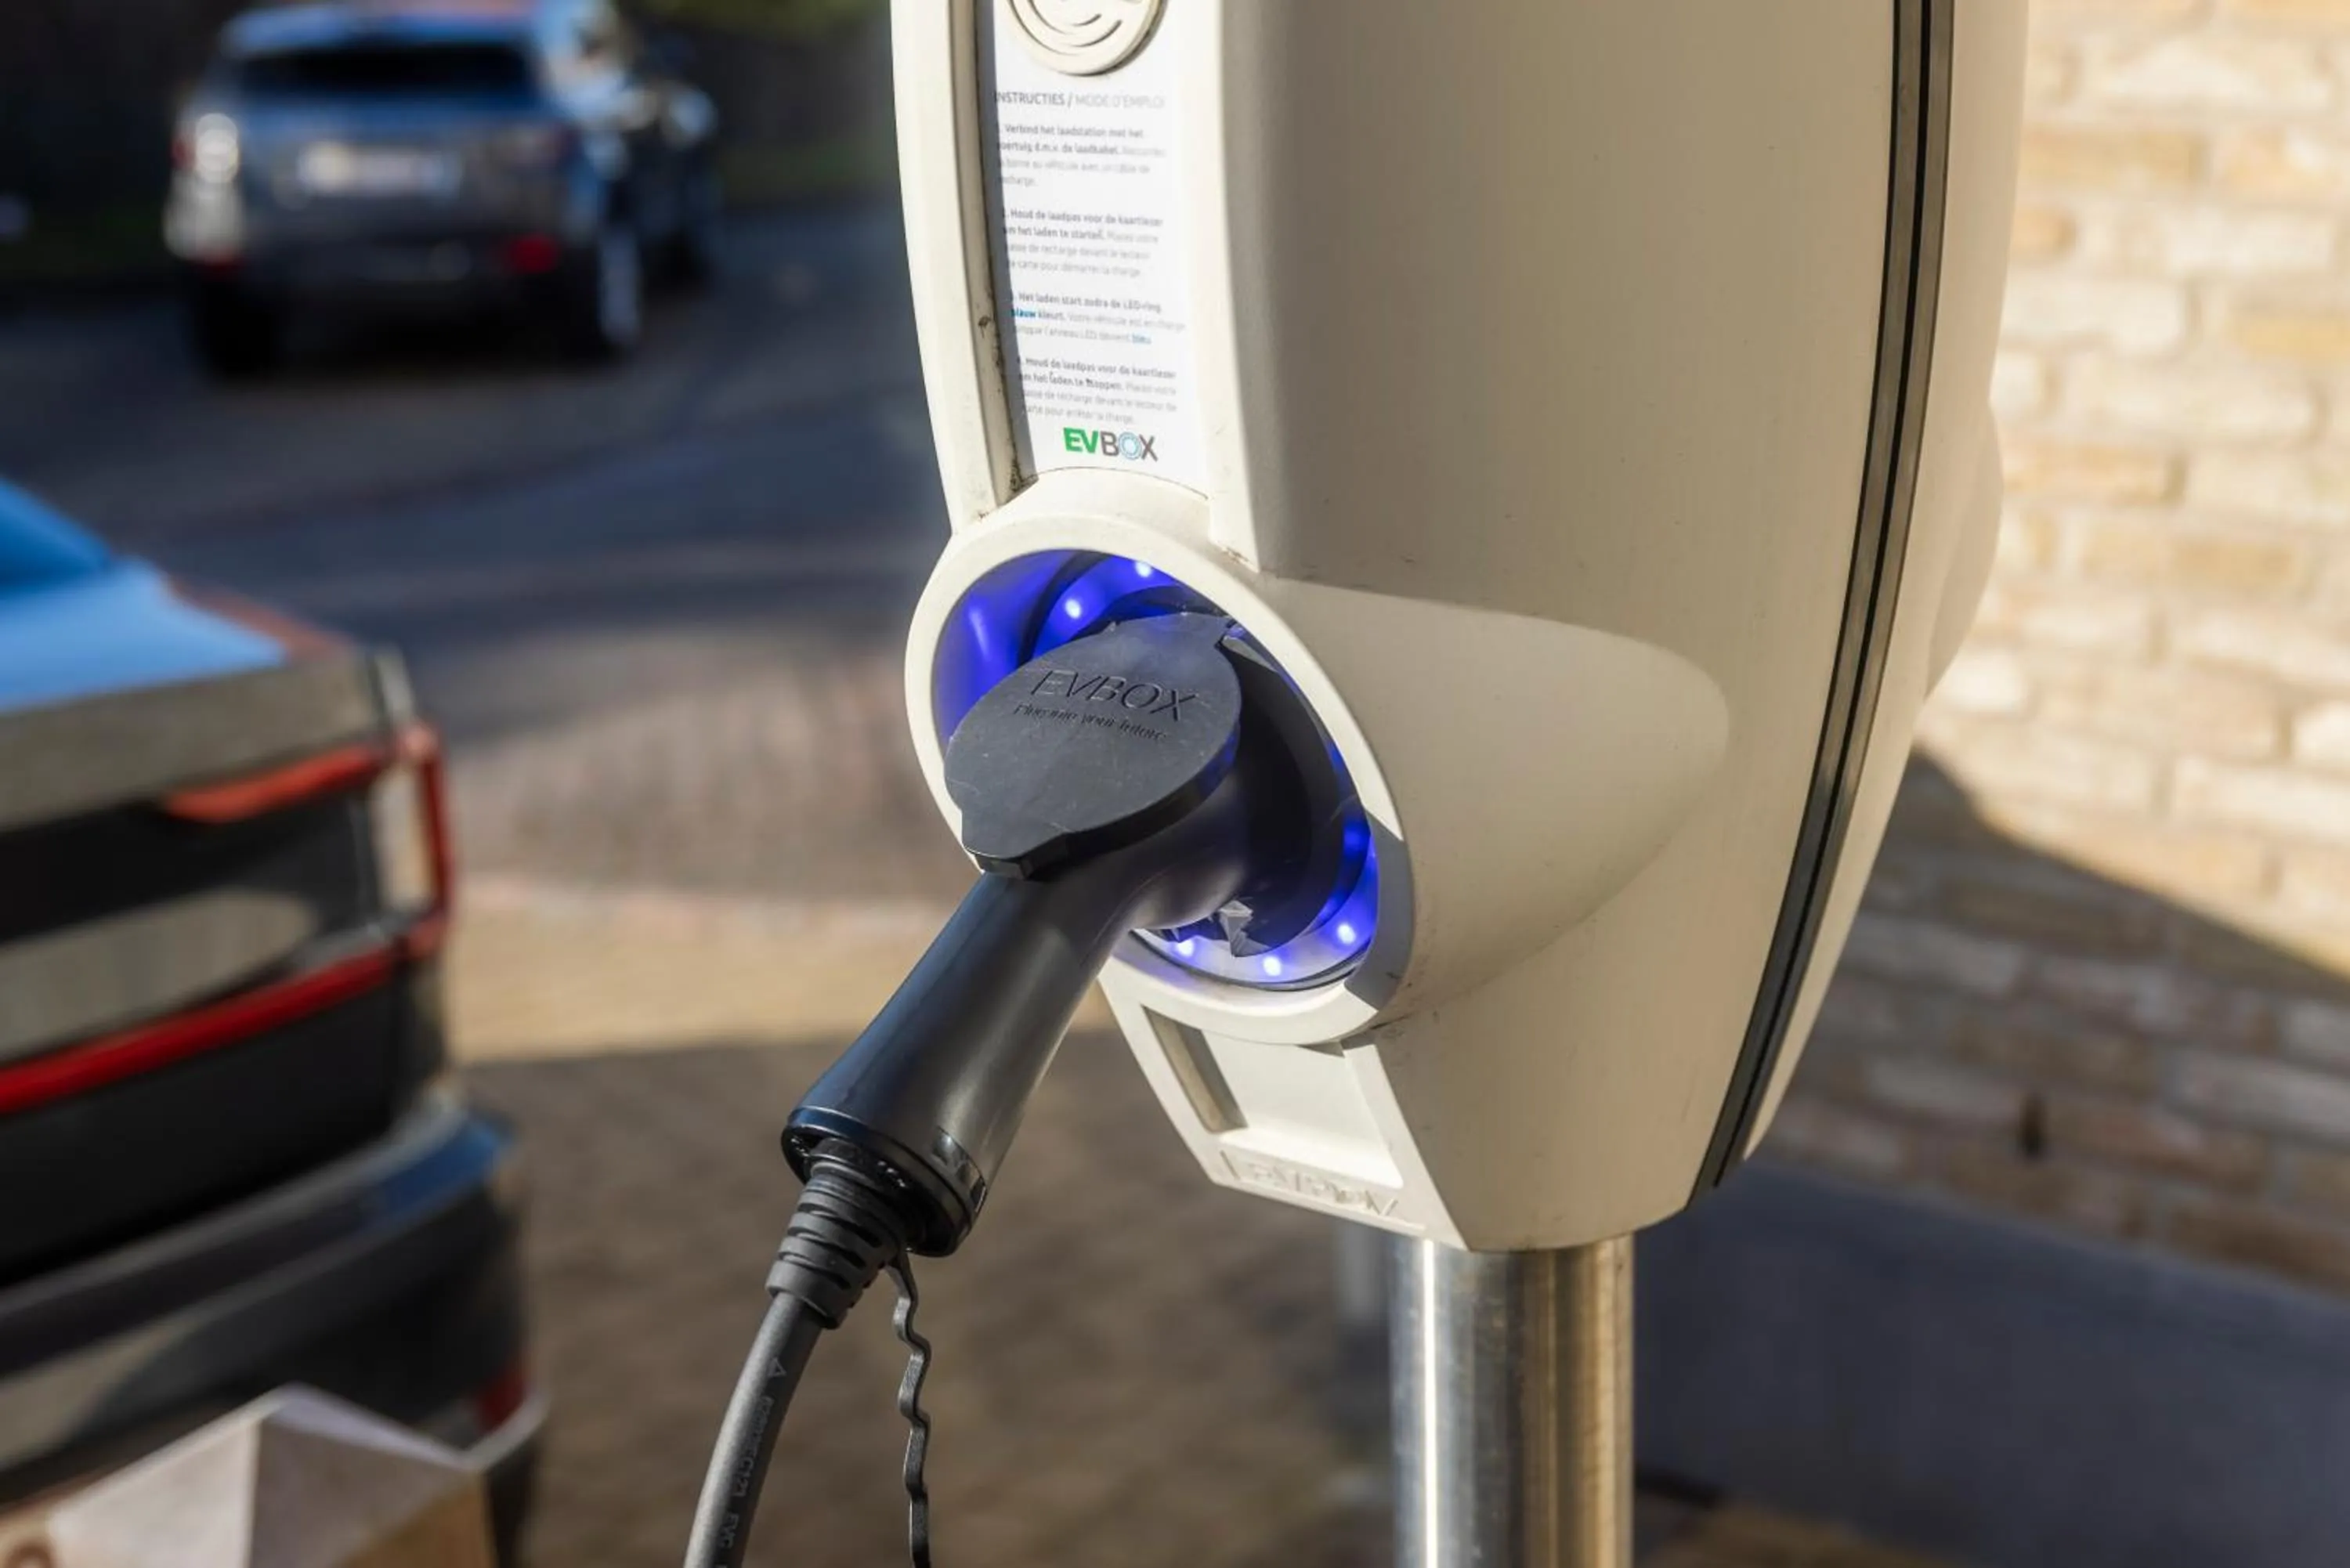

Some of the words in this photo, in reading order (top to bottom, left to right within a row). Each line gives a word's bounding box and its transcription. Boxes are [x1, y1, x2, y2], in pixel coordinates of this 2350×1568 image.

[998, 142, 1033, 153] oertuig
[1063, 427, 1158, 462] EVBOX
[1029, 670, 1200, 722] EVBOX
